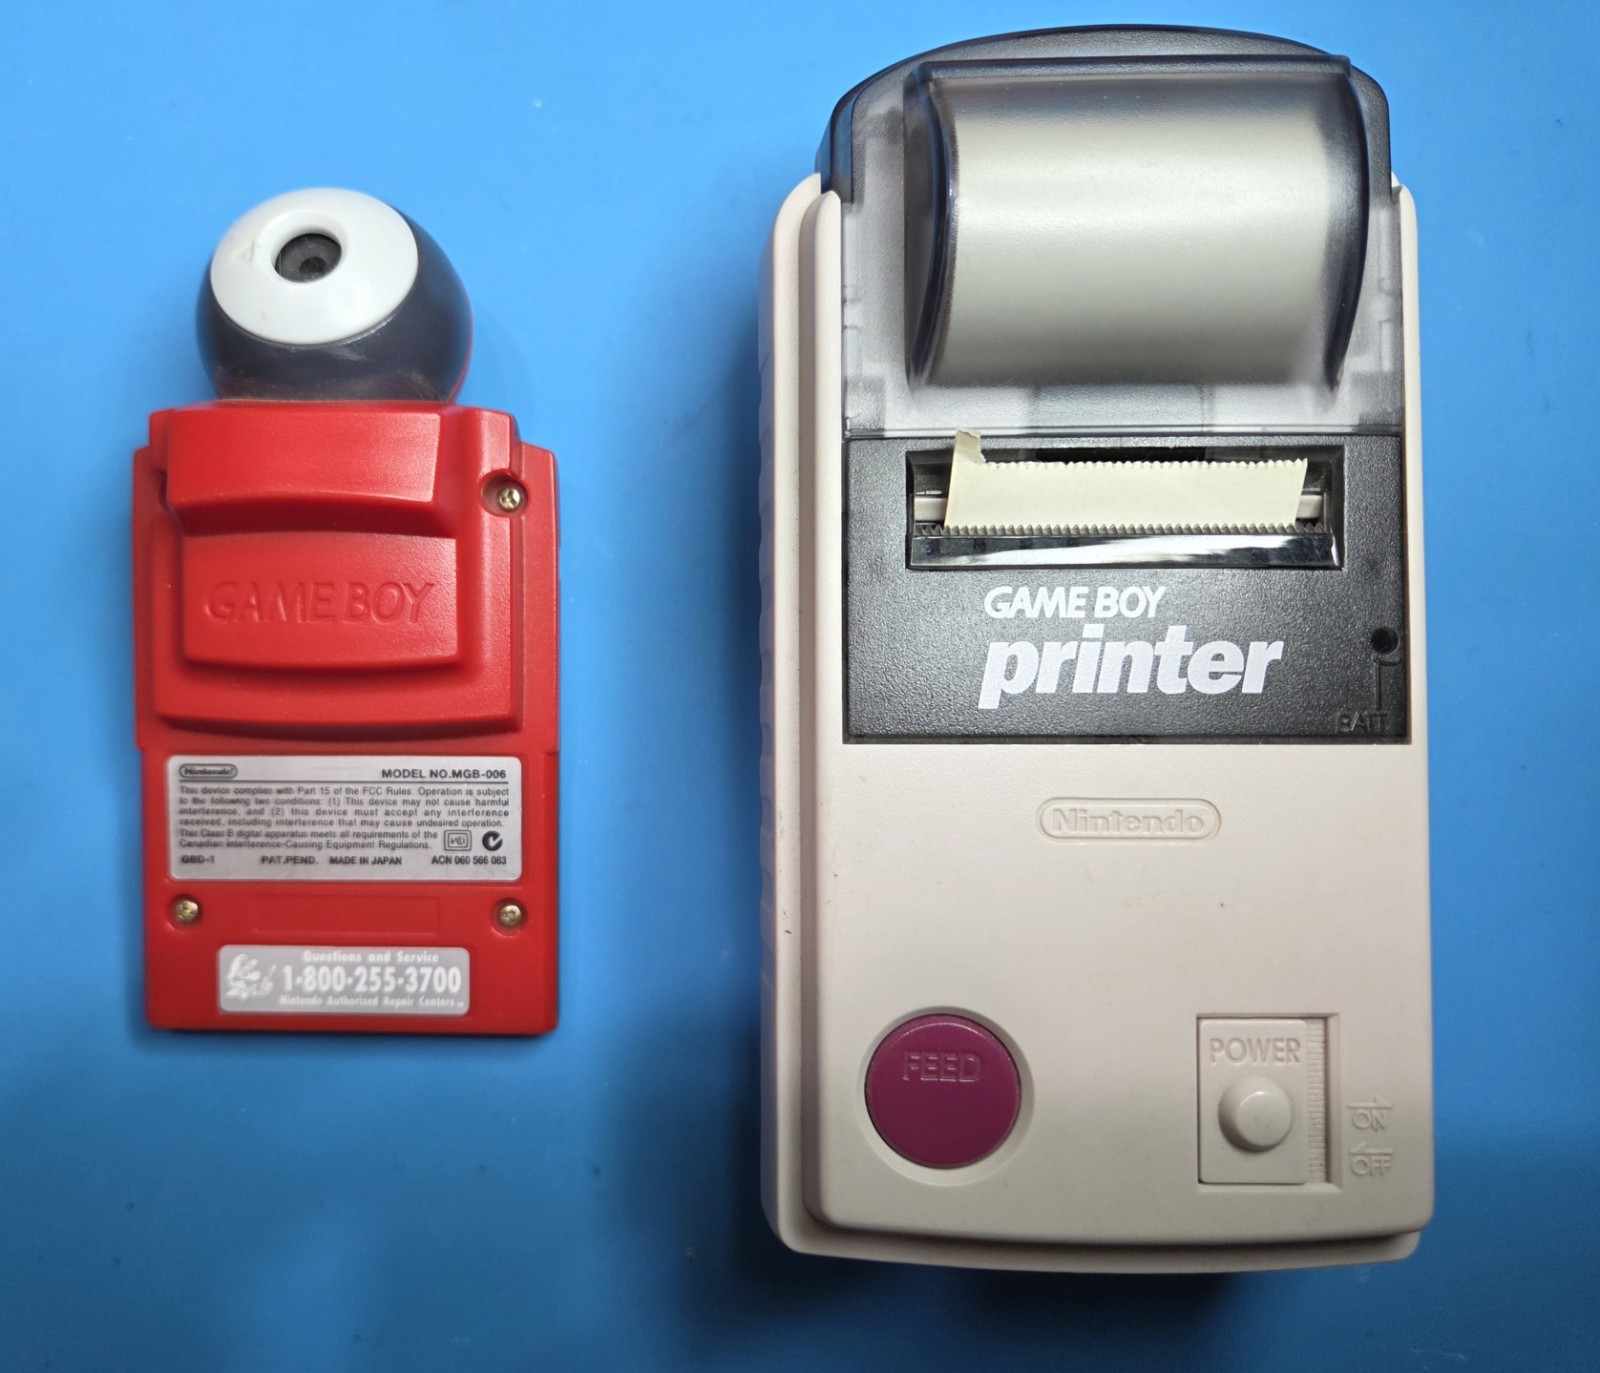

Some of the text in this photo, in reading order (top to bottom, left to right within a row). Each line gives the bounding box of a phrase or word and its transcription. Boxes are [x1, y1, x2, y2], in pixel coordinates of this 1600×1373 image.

[203, 581, 435, 625] GAME BOY
[984, 585, 1166, 618] GAME BOY
[977, 623, 1285, 710] printer
[381, 768, 427, 779] MODEL
[180, 786, 198, 795] This
[201, 786, 230, 795] device
[234, 786, 273, 797] complies
[276, 786, 294, 795] with
[297, 786, 316, 795] Part
[319, 786, 330, 795] 15
[334, 786, 342, 795] of
[345, 787, 360, 796] the
[362, 787, 382, 796] FCC
[418, 787, 462, 798] Operation
[466, 787, 474, 796] is
[476, 787, 510, 798] subject
[180, 796, 188, 805] to
[192, 796, 206, 805] the
[210, 796, 250, 807] following
[254, 796, 270, 805] two
[328, 797, 341, 807] (1)
[346, 797, 364, 806] This
[368, 797, 398, 806] device
[402, 799, 420, 808] may
[426, 798, 440, 806] not
[475, 798, 510, 806] harmful
[246, 807, 264, 815] and
[270, 807, 284, 817] (2)
[290, 807, 309, 816] this
[315, 807, 348, 816] device
[354, 808, 378, 816] must
[384, 808, 418, 818] accept
[424, 810, 442, 818] any
[448, 808, 510, 817] interference
[228, 817, 272, 828] including
[276, 818, 334, 827] interference
[338, 818, 357, 827] that
[360, 819, 380, 829] may
[384, 819, 412, 827] cause
[416, 818, 458, 827] undesired
[461, 818, 504, 829] operation.
[1052, 808, 1205, 834] Nintendo
[180, 829, 438, 841] This Class B digital apparatus meets all requirements of the
[180, 839, 224, 848] Canadian
[326, 840, 376, 851] Equipment
[378, 840, 432, 851] Regulations.
[330, 856, 402, 866] MADE IN JAPAN
[431, 856, 507, 866] ACN 060 566 083
[303, 951, 439, 963] Questions and Service
[282, 965, 462, 993] 1-800-255-3700
[279, 995, 323, 1005] Nintendo
[327, 995, 379, 1006] Authorized
[384, 996, 414, 1008] Repair
[420, 996, 455, 1007] Centers
[1209, 1037, 1301, 1065] POWER
[903, 1050, 981, 1082] FEED
[1352, 1109, 1387, 1131] ON
[1351, 1155, 1392, 1177] OFF
